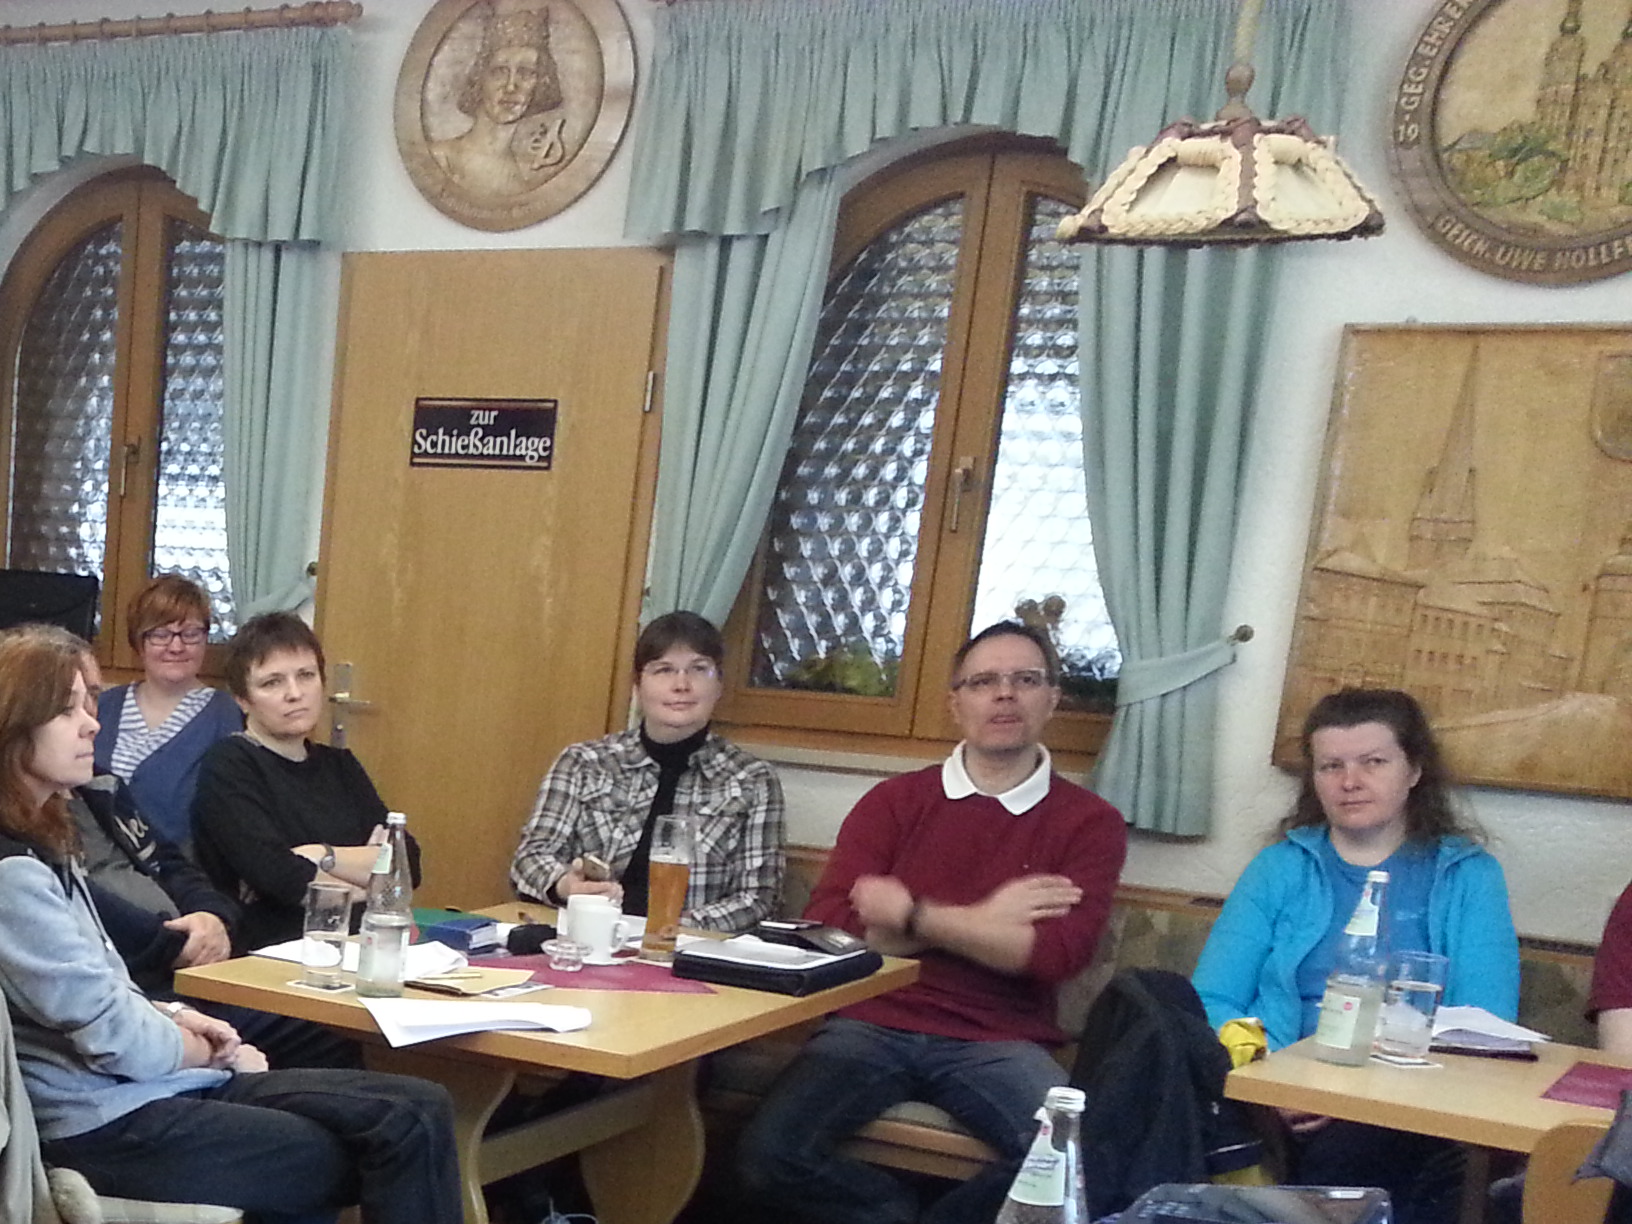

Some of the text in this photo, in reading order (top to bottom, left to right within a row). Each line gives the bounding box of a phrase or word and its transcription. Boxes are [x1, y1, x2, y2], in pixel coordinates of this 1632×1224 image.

[1496, 246, 1546, 270] UWE
[469, 409, 499, 425] zur
[413, 427, 552, 463] Schießanlage
